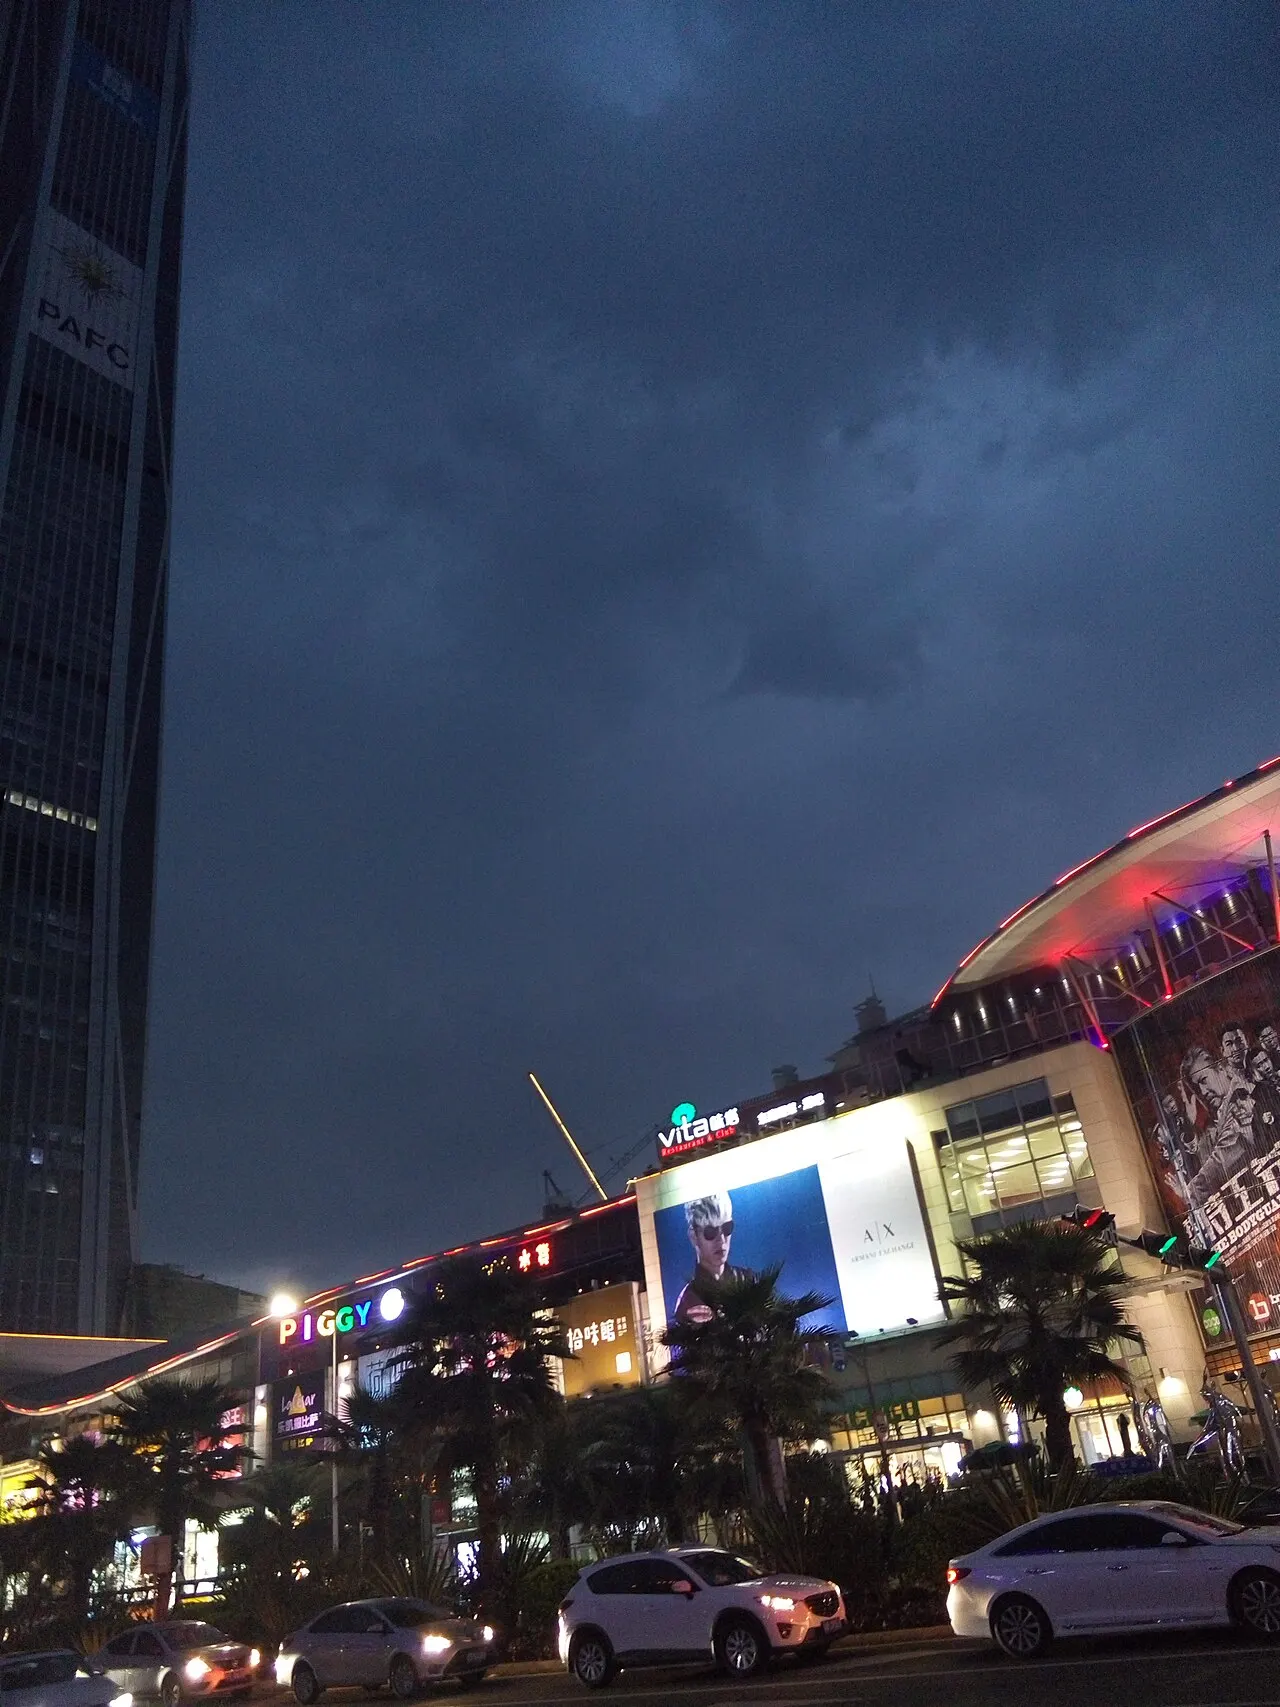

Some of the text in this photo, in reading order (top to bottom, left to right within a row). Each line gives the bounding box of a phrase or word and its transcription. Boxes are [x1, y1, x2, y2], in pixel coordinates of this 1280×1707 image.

[37, 298, 131, 369] PAFC
[658, 1116, 708, 1148] vita
[661, 1138, 705, 1157] Restaurant
[715, 1125, 736, 1139] Club
[279, 1300, 371, 1345] PIGGY
